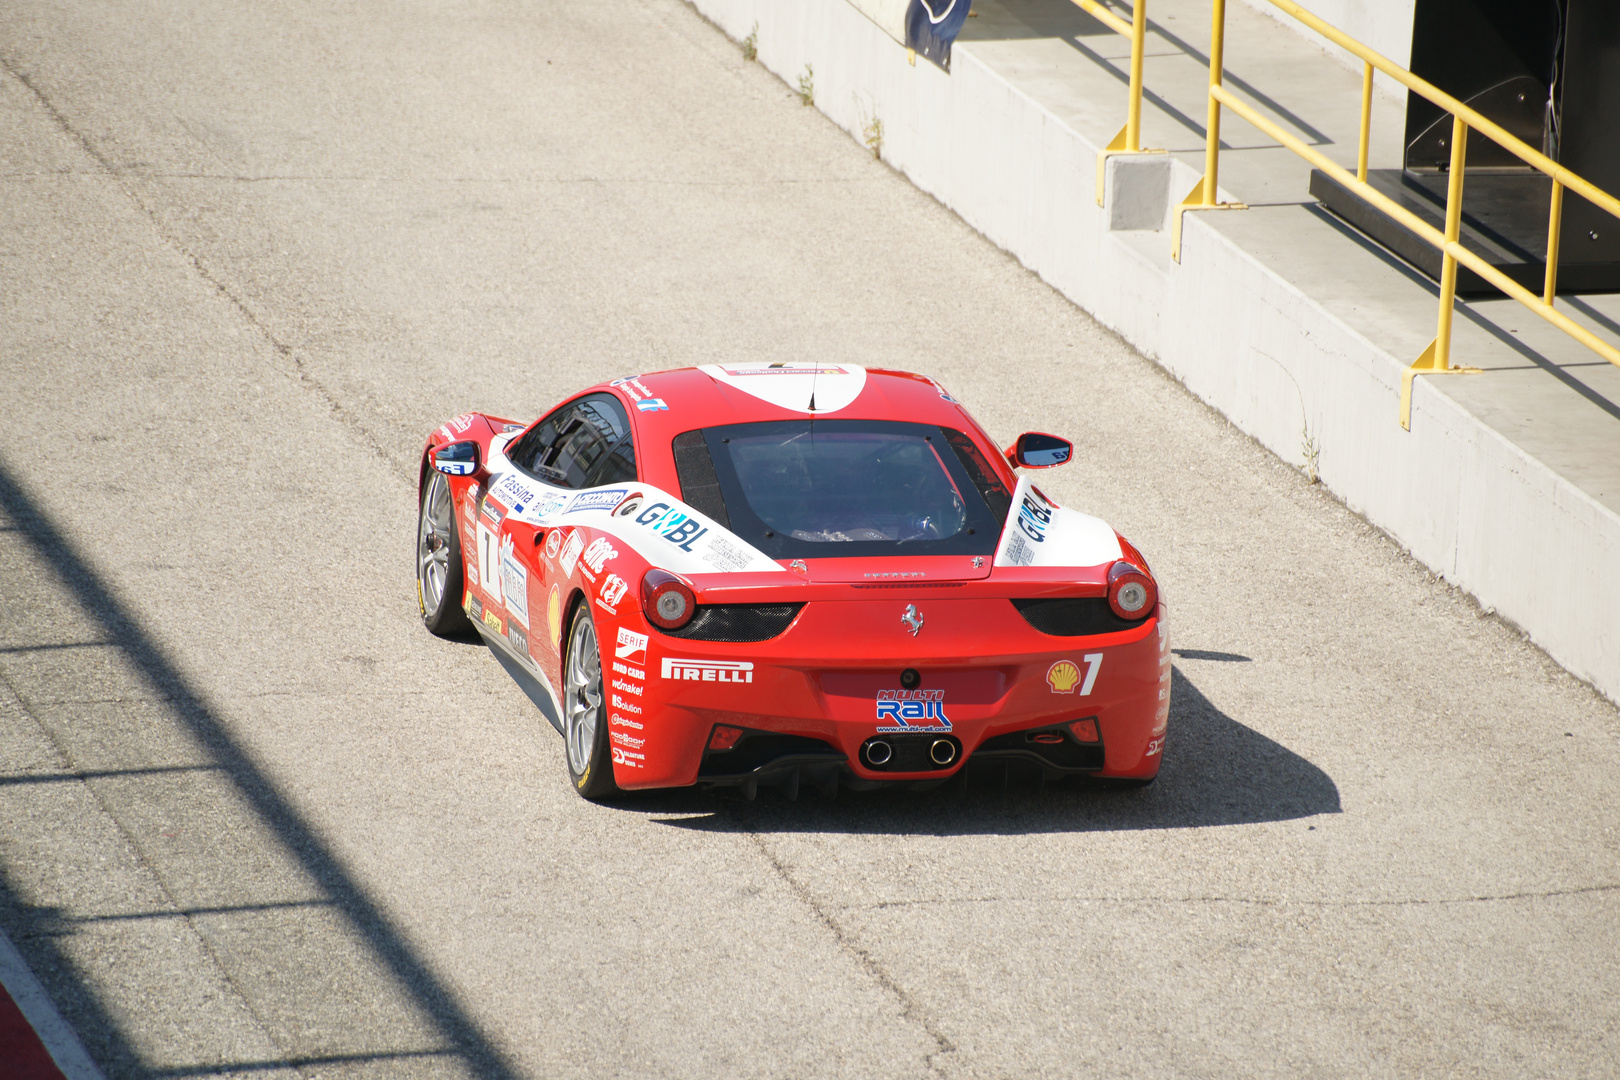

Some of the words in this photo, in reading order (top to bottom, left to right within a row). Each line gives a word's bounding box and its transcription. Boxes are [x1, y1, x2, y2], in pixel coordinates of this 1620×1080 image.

[492, 486, 517, 508] AUTOMOTIVE
[500, 474, 534, 504] Fassina
[635, 502, 709, 553] G&BL
[619, 632, 645, 648] SERIF
[612, 661, 628, 675] NORD
[627, 666, 646, 681] CARR
[661, 657, 754, 683] PIRELLI
[1079, 653, 1104, 697] 7
[877, 689, 945, 700] MULTI
[876, 701, 953, 728] Rail
